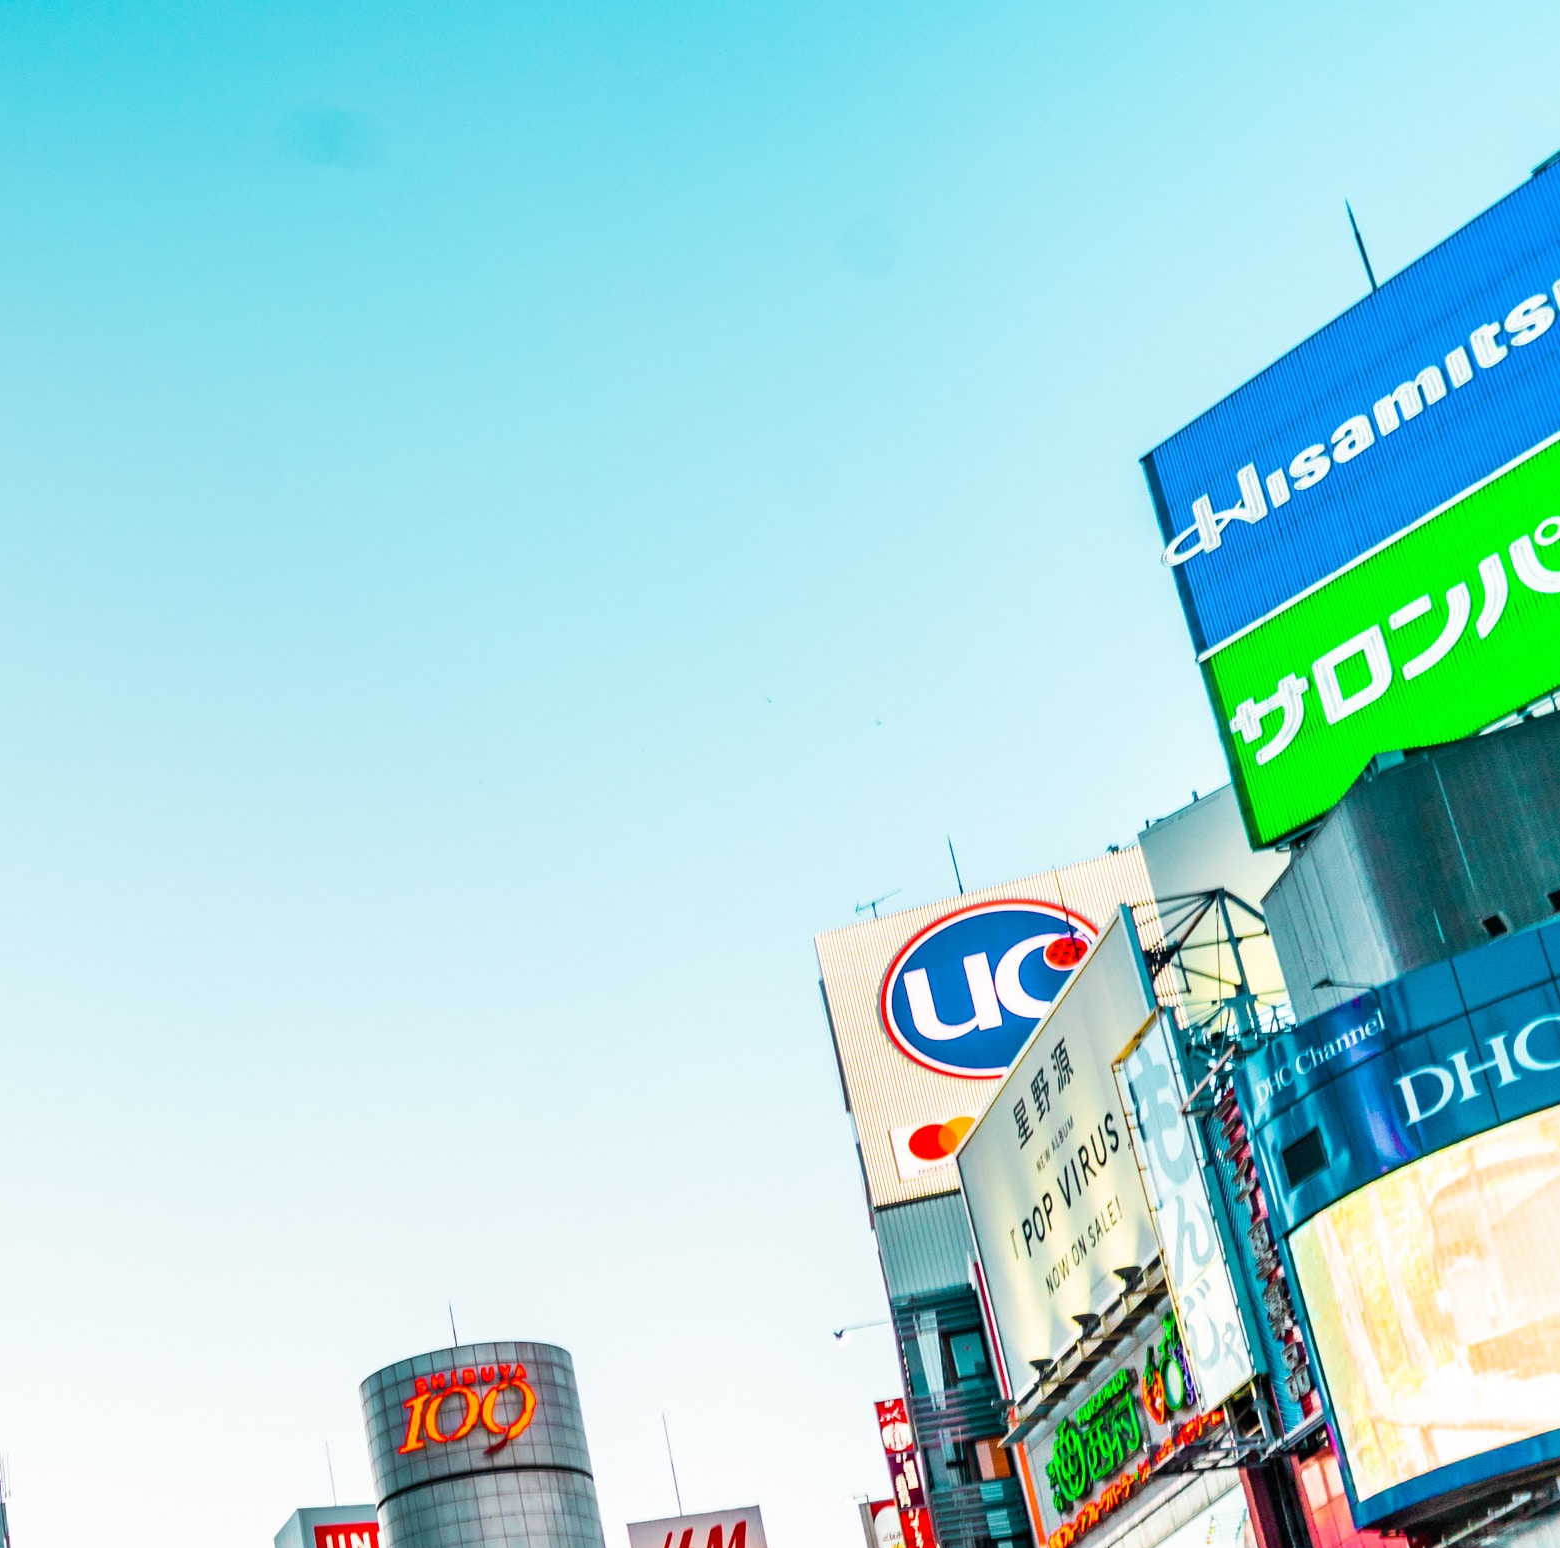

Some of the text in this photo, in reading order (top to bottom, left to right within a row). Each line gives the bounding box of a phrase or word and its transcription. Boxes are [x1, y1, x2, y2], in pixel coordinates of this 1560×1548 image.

[1161, 279, 1560, 567] Hisamits
[1295, 1009, 1385, 1076] Channel
[1012, 1037, 1075, 1150] 星野源
[1036, 1112, 1075, 1175] NEW ALBUM
[1045, 1194, 1123, 1299] NOW ON SALE!
[399, 1374, 536, 1456] 109
[415, 1363, 528, 1393] SHIBUYA
